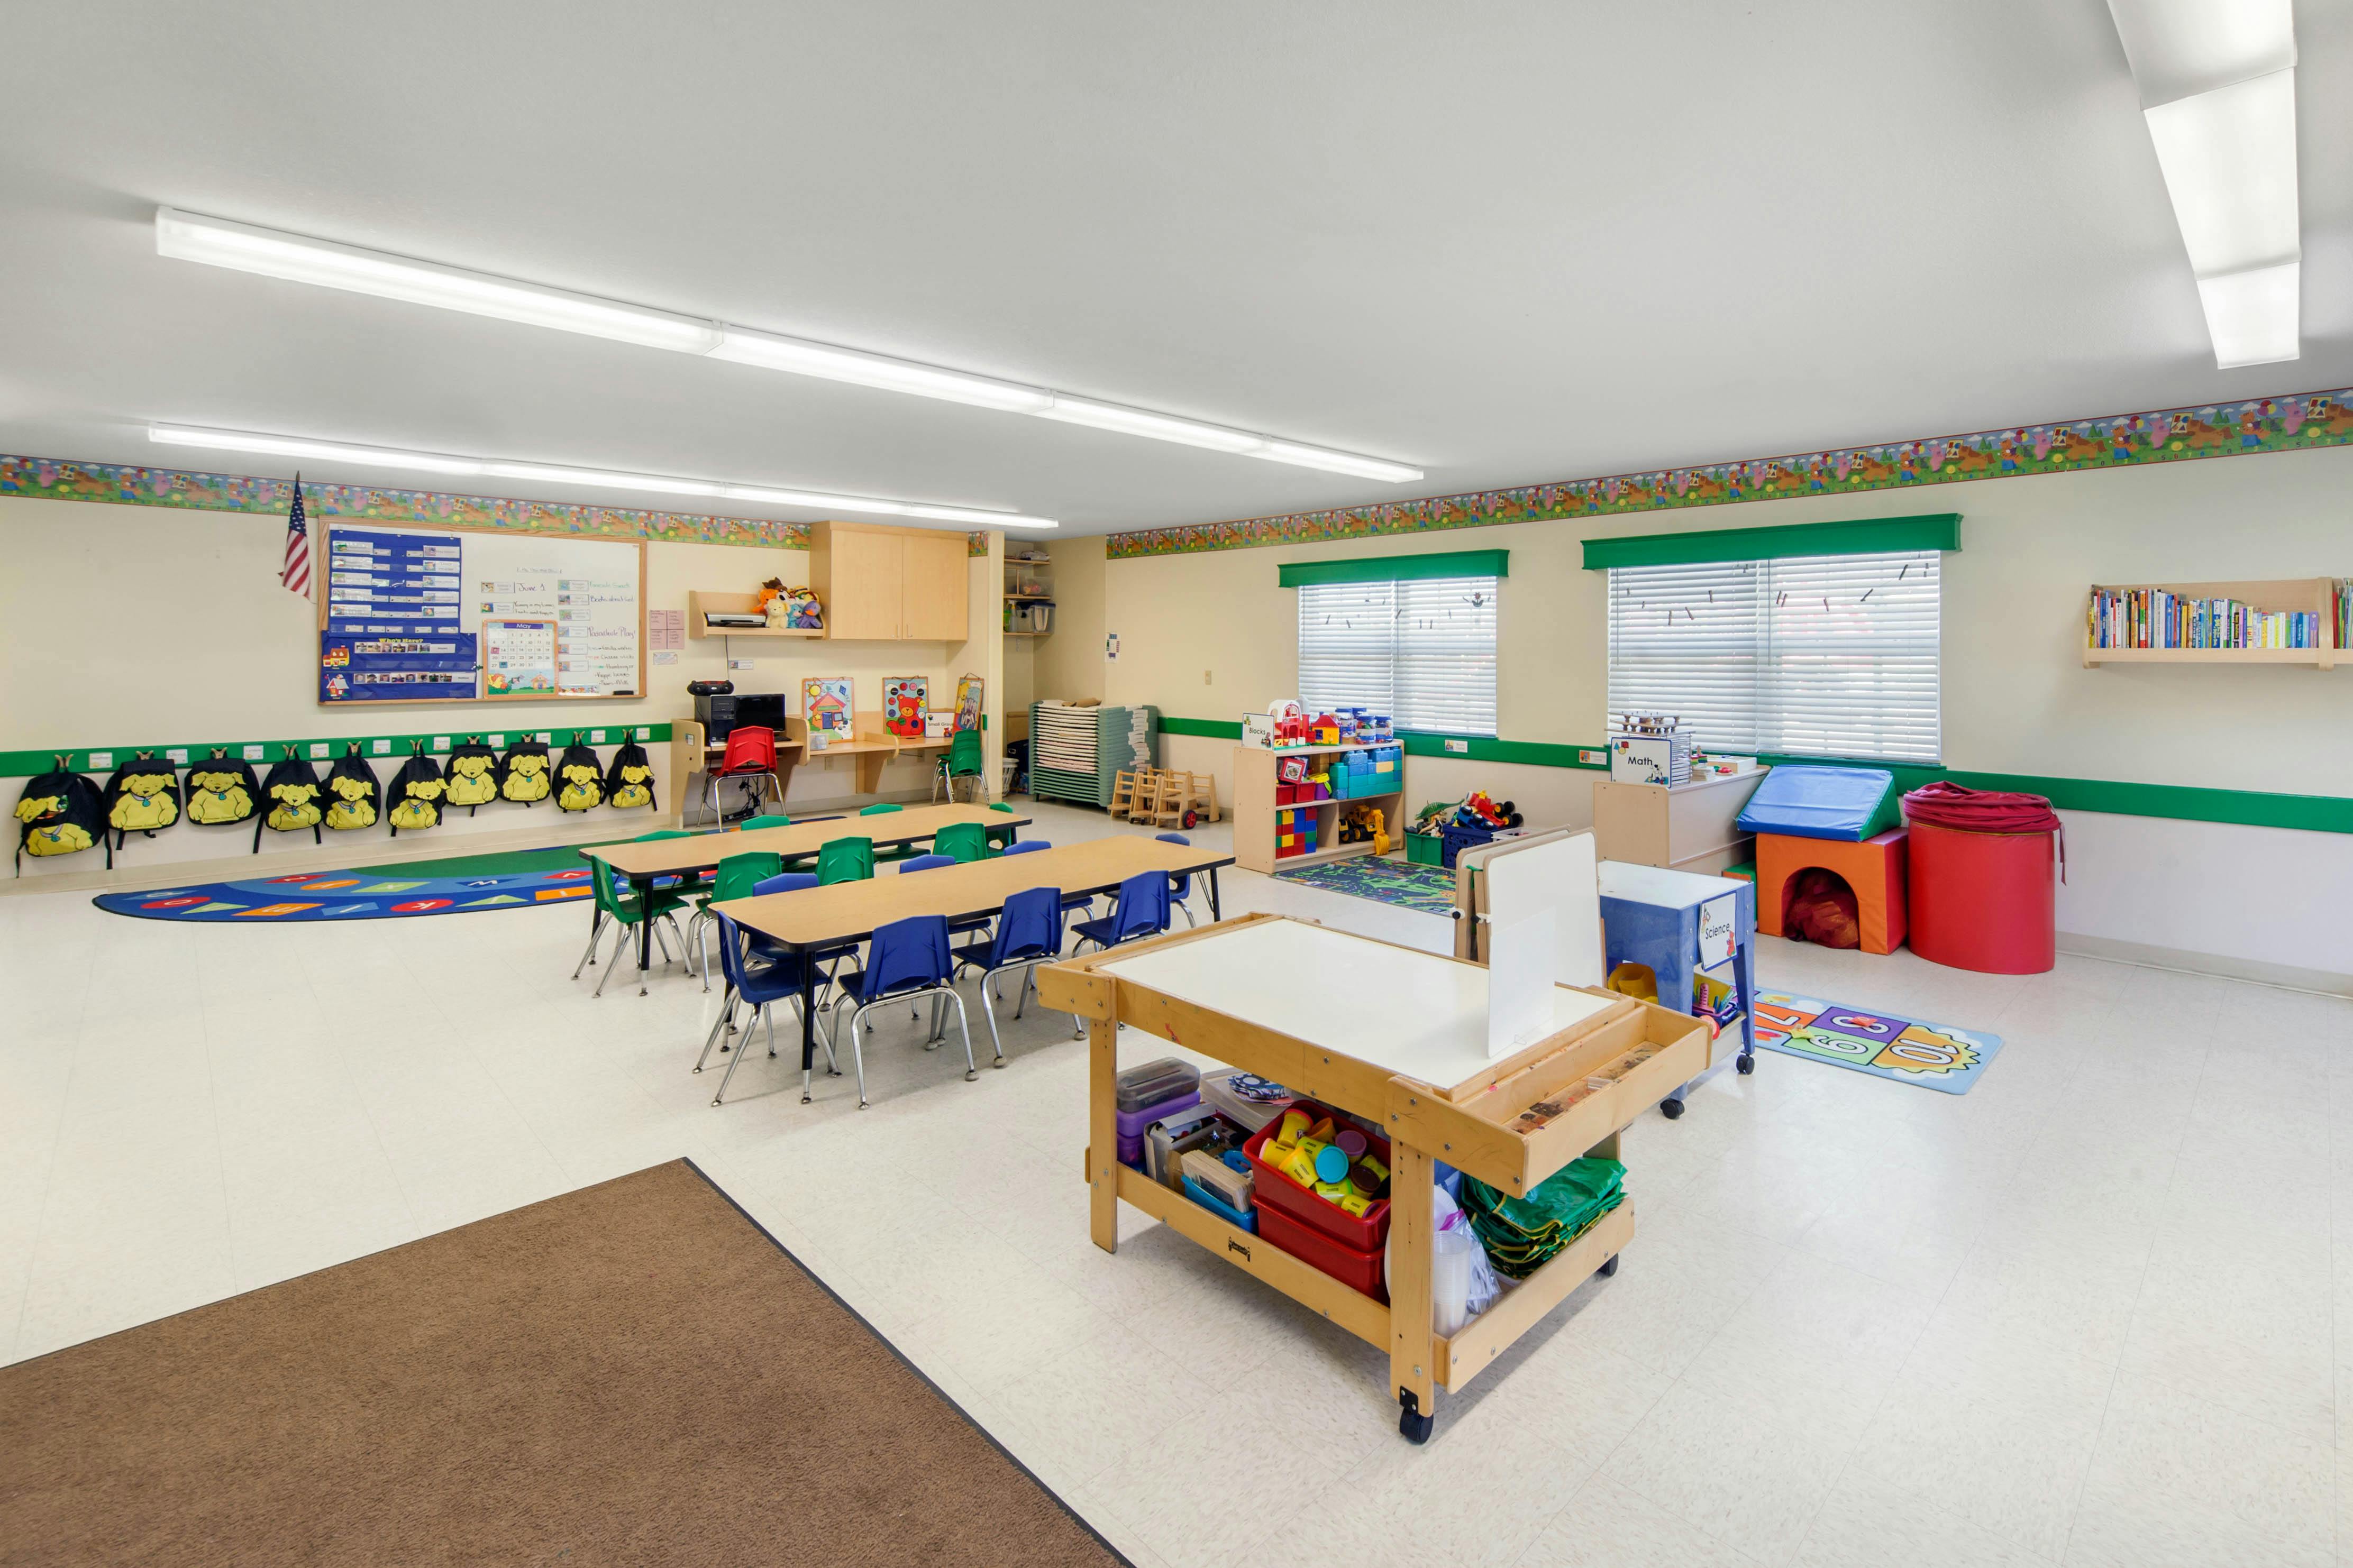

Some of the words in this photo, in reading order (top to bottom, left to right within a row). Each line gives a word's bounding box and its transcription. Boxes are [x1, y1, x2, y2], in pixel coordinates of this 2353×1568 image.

[517, 583, 536, 592] June
[1628, 756, 1653, 766] Math
[1705, 923, 1730, 940] Science
[1754, 1010, 1801, 1026] 7
[1830, 1015, 1890, 1034] 8
[1808, 1035, 1868, 1054] 9
[1889, 1038, 1960, 1065] 10
